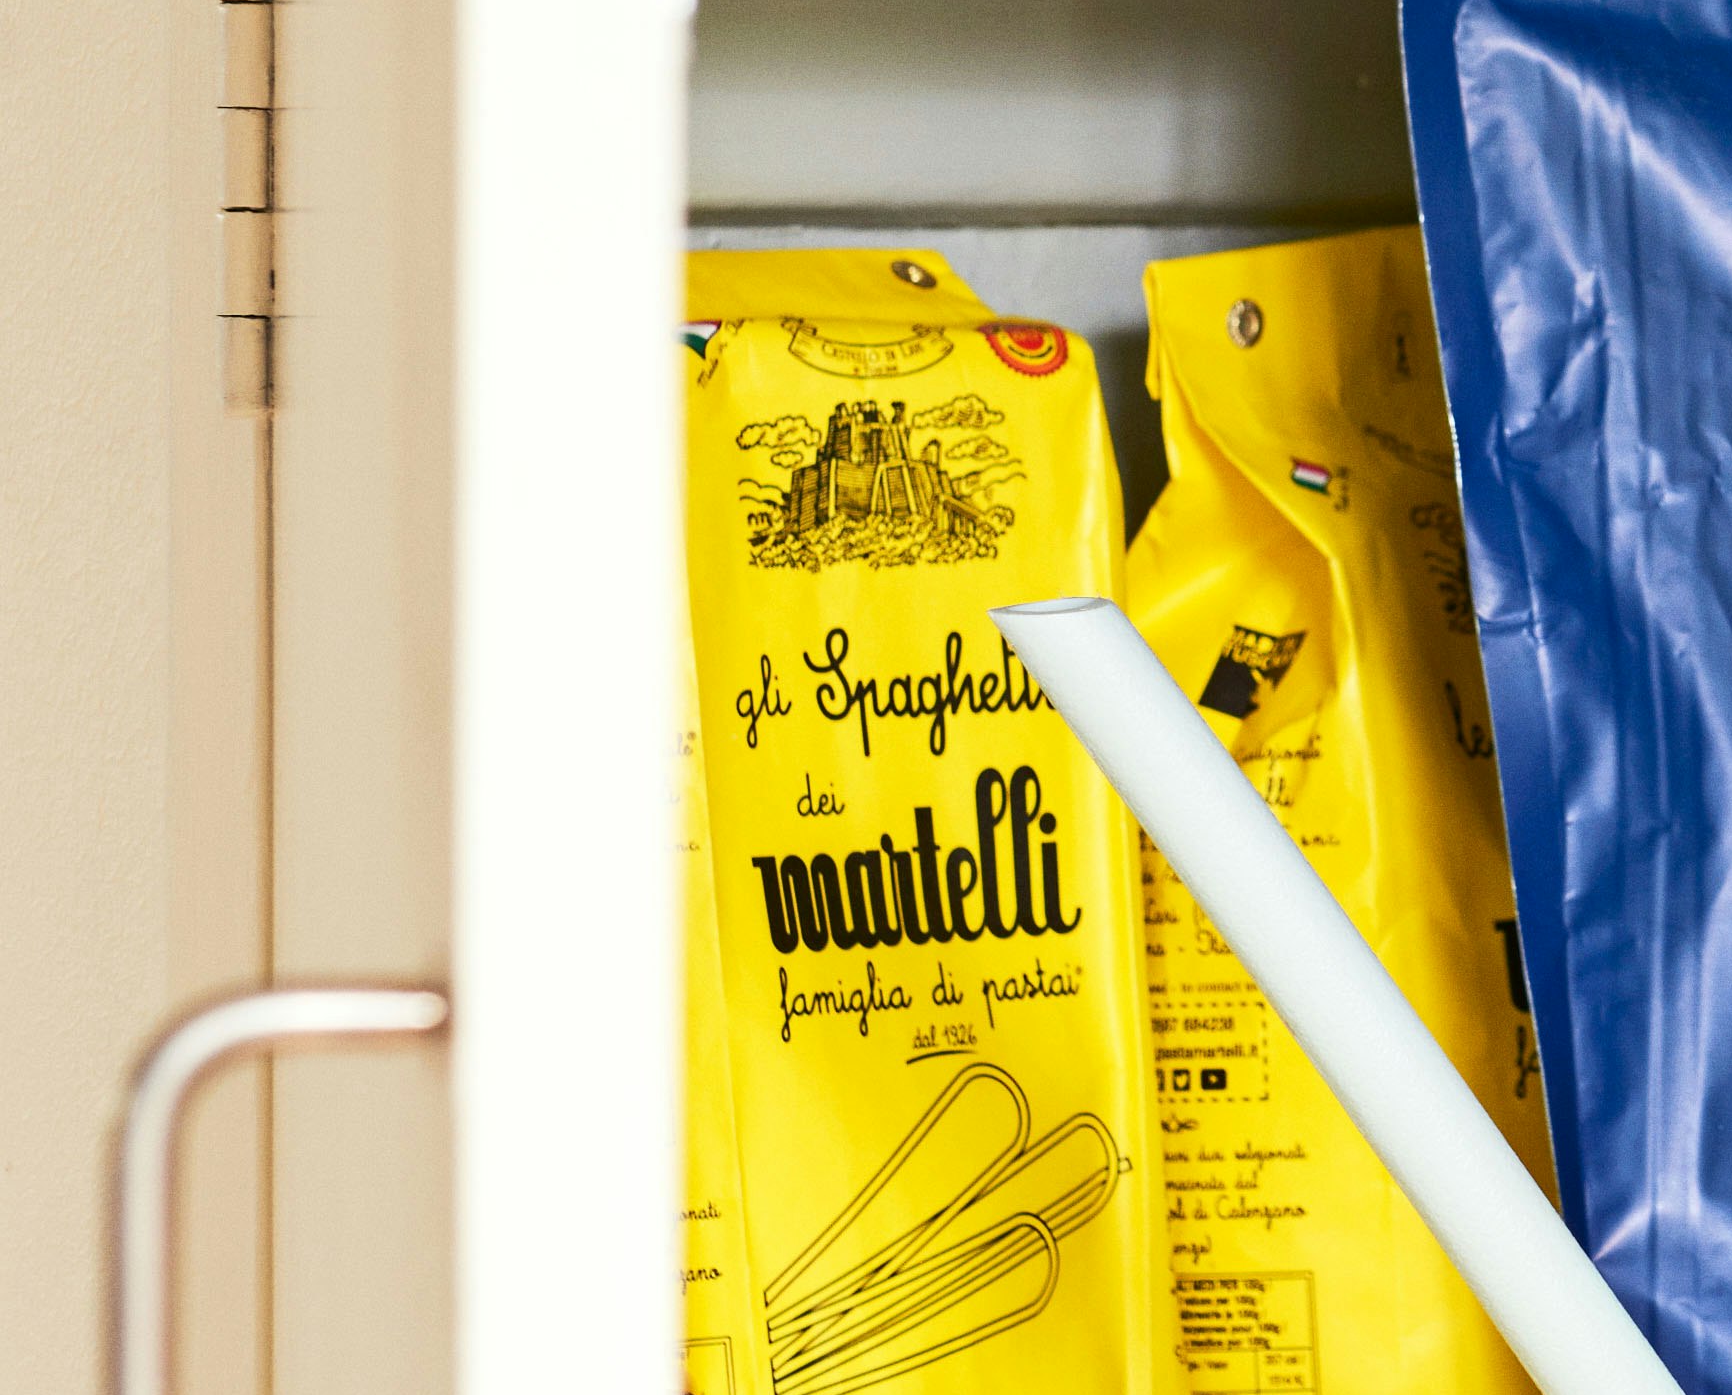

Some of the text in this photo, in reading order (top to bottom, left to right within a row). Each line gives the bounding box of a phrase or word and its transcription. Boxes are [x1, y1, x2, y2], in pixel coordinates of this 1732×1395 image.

[735, 628, 1057, 757] gli Spaghett
[797, 773, 845, 816] dei
[752, 765, 1082, 954] martelli
[778, 961, 912, 1042] famiglia
[932, 962, 963, 1006] di
[913, 1024, 978, 1050] dal 1926
